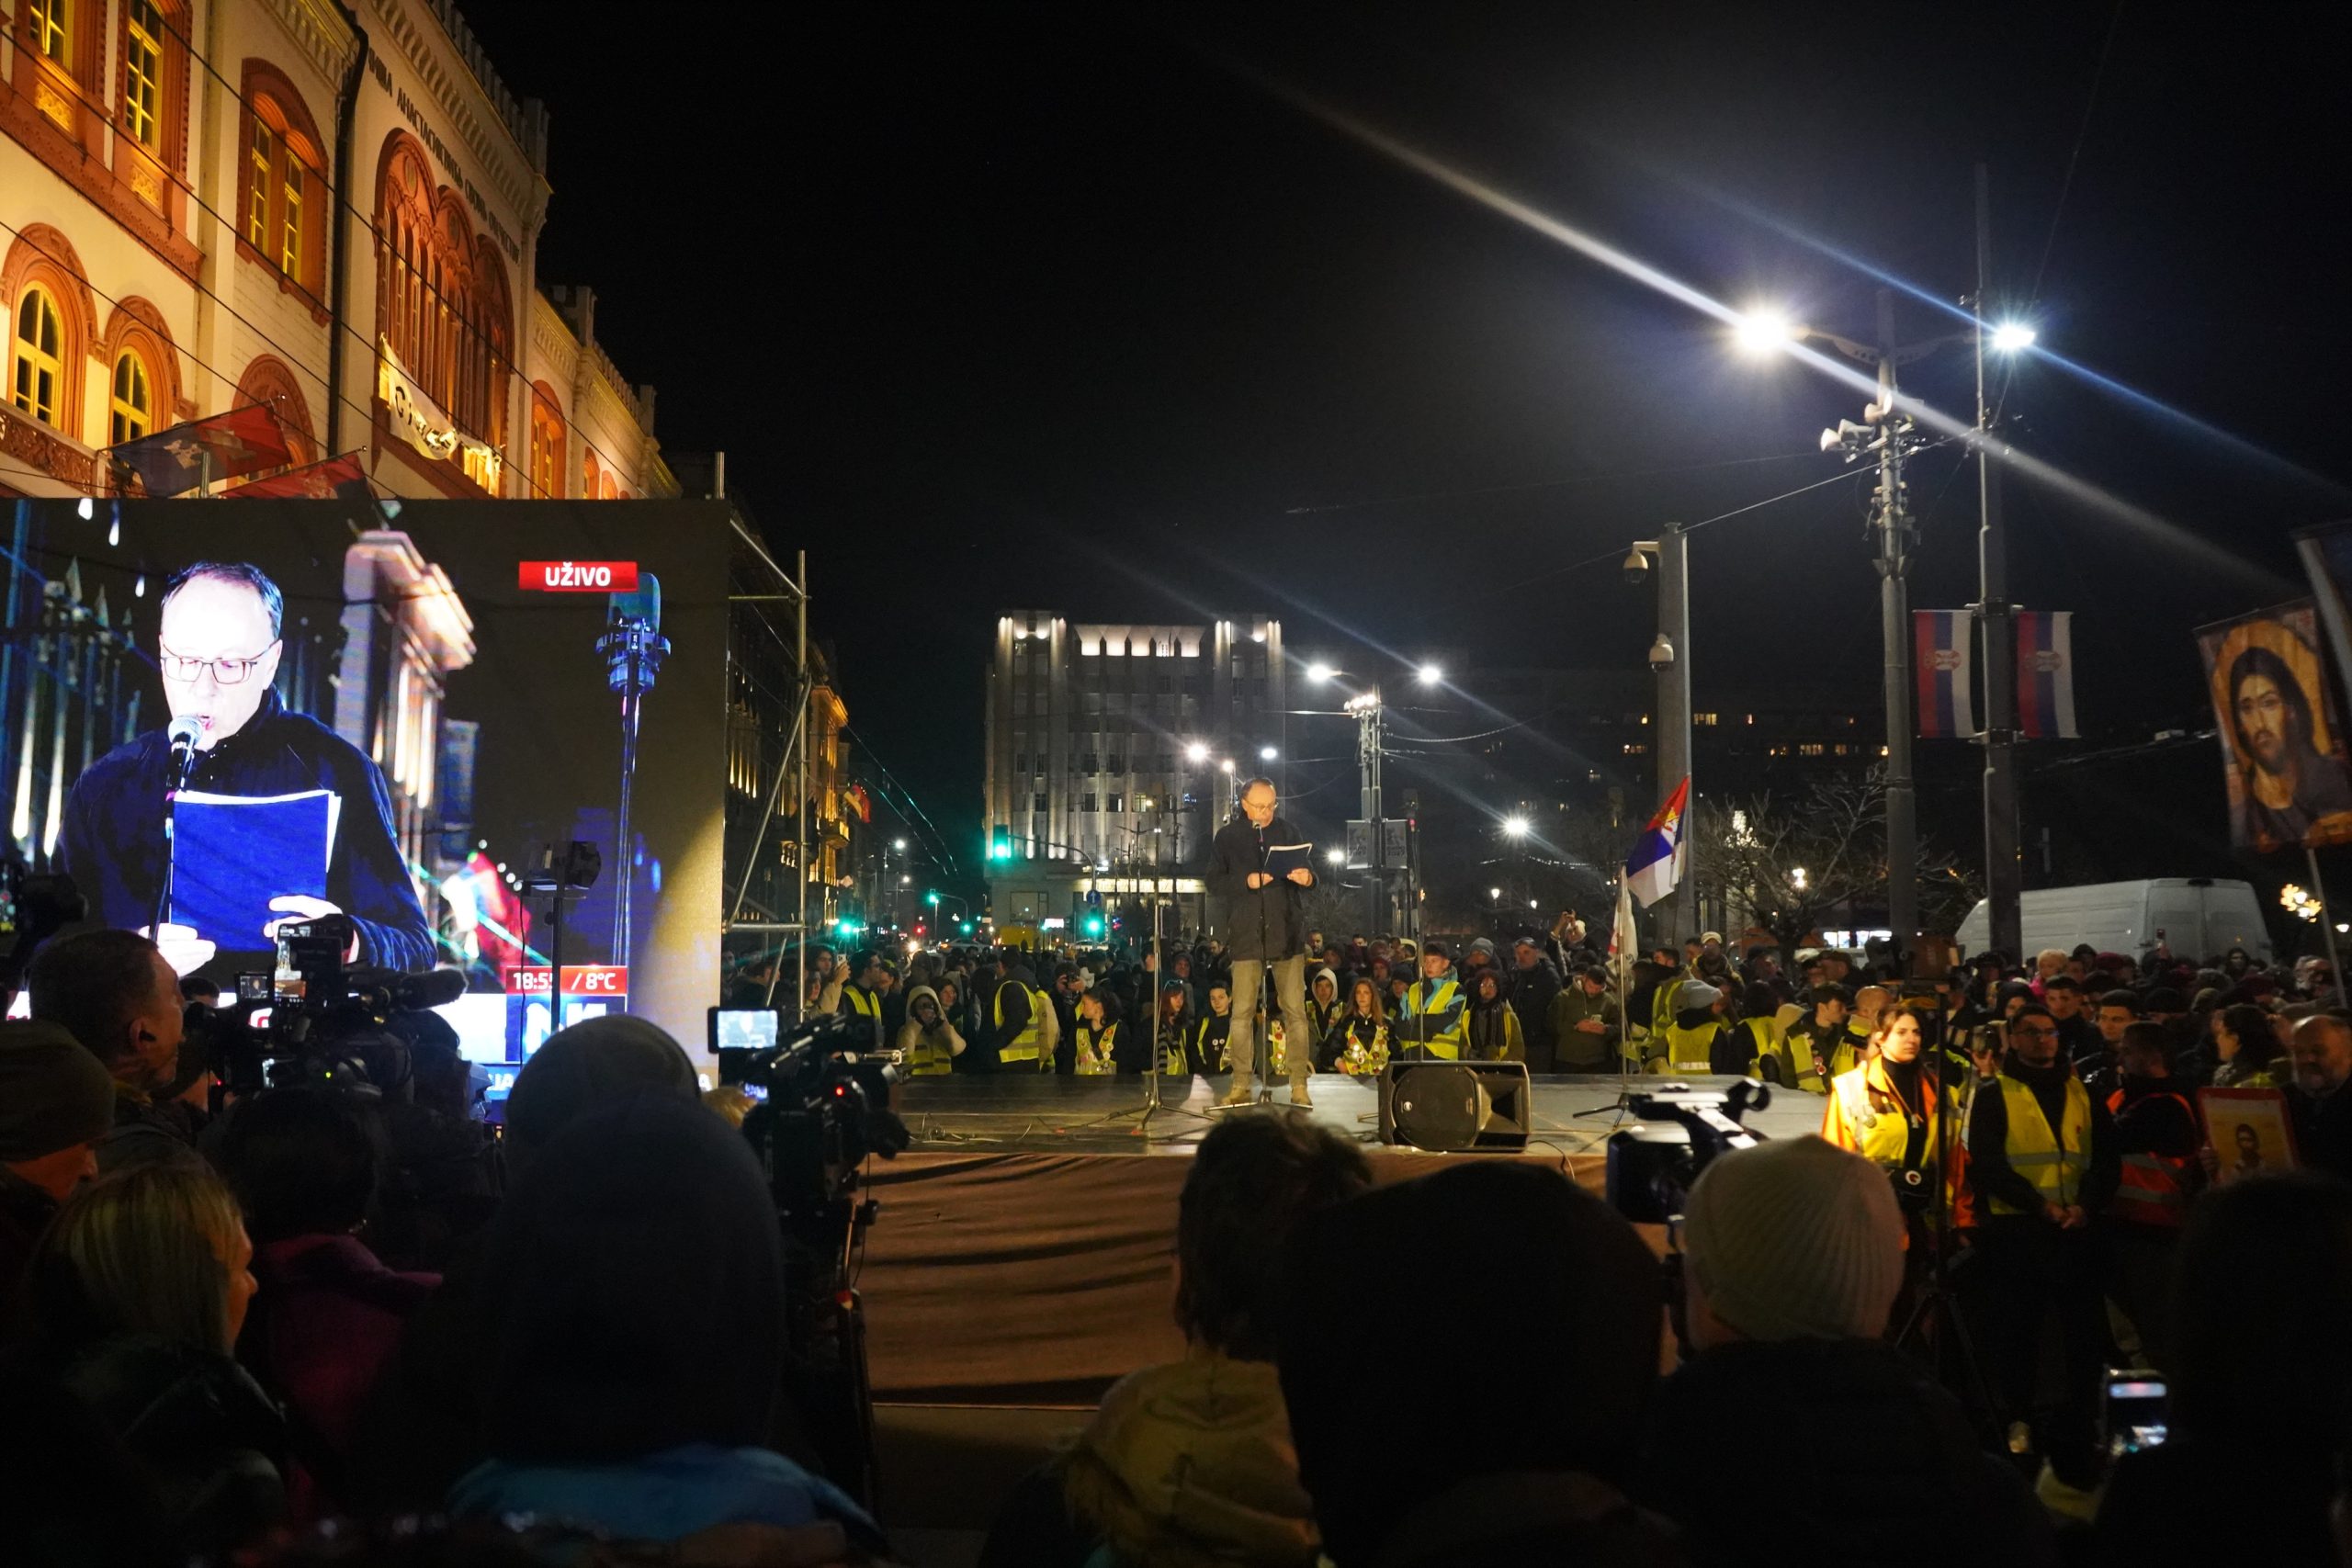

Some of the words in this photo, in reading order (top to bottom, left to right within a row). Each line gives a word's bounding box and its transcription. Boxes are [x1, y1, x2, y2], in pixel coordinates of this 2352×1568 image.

[545, 561, 611, 586] UŽIVO
[513, 972, 553, 990] 18:5
[585, 972, 616, 990] 8°C
